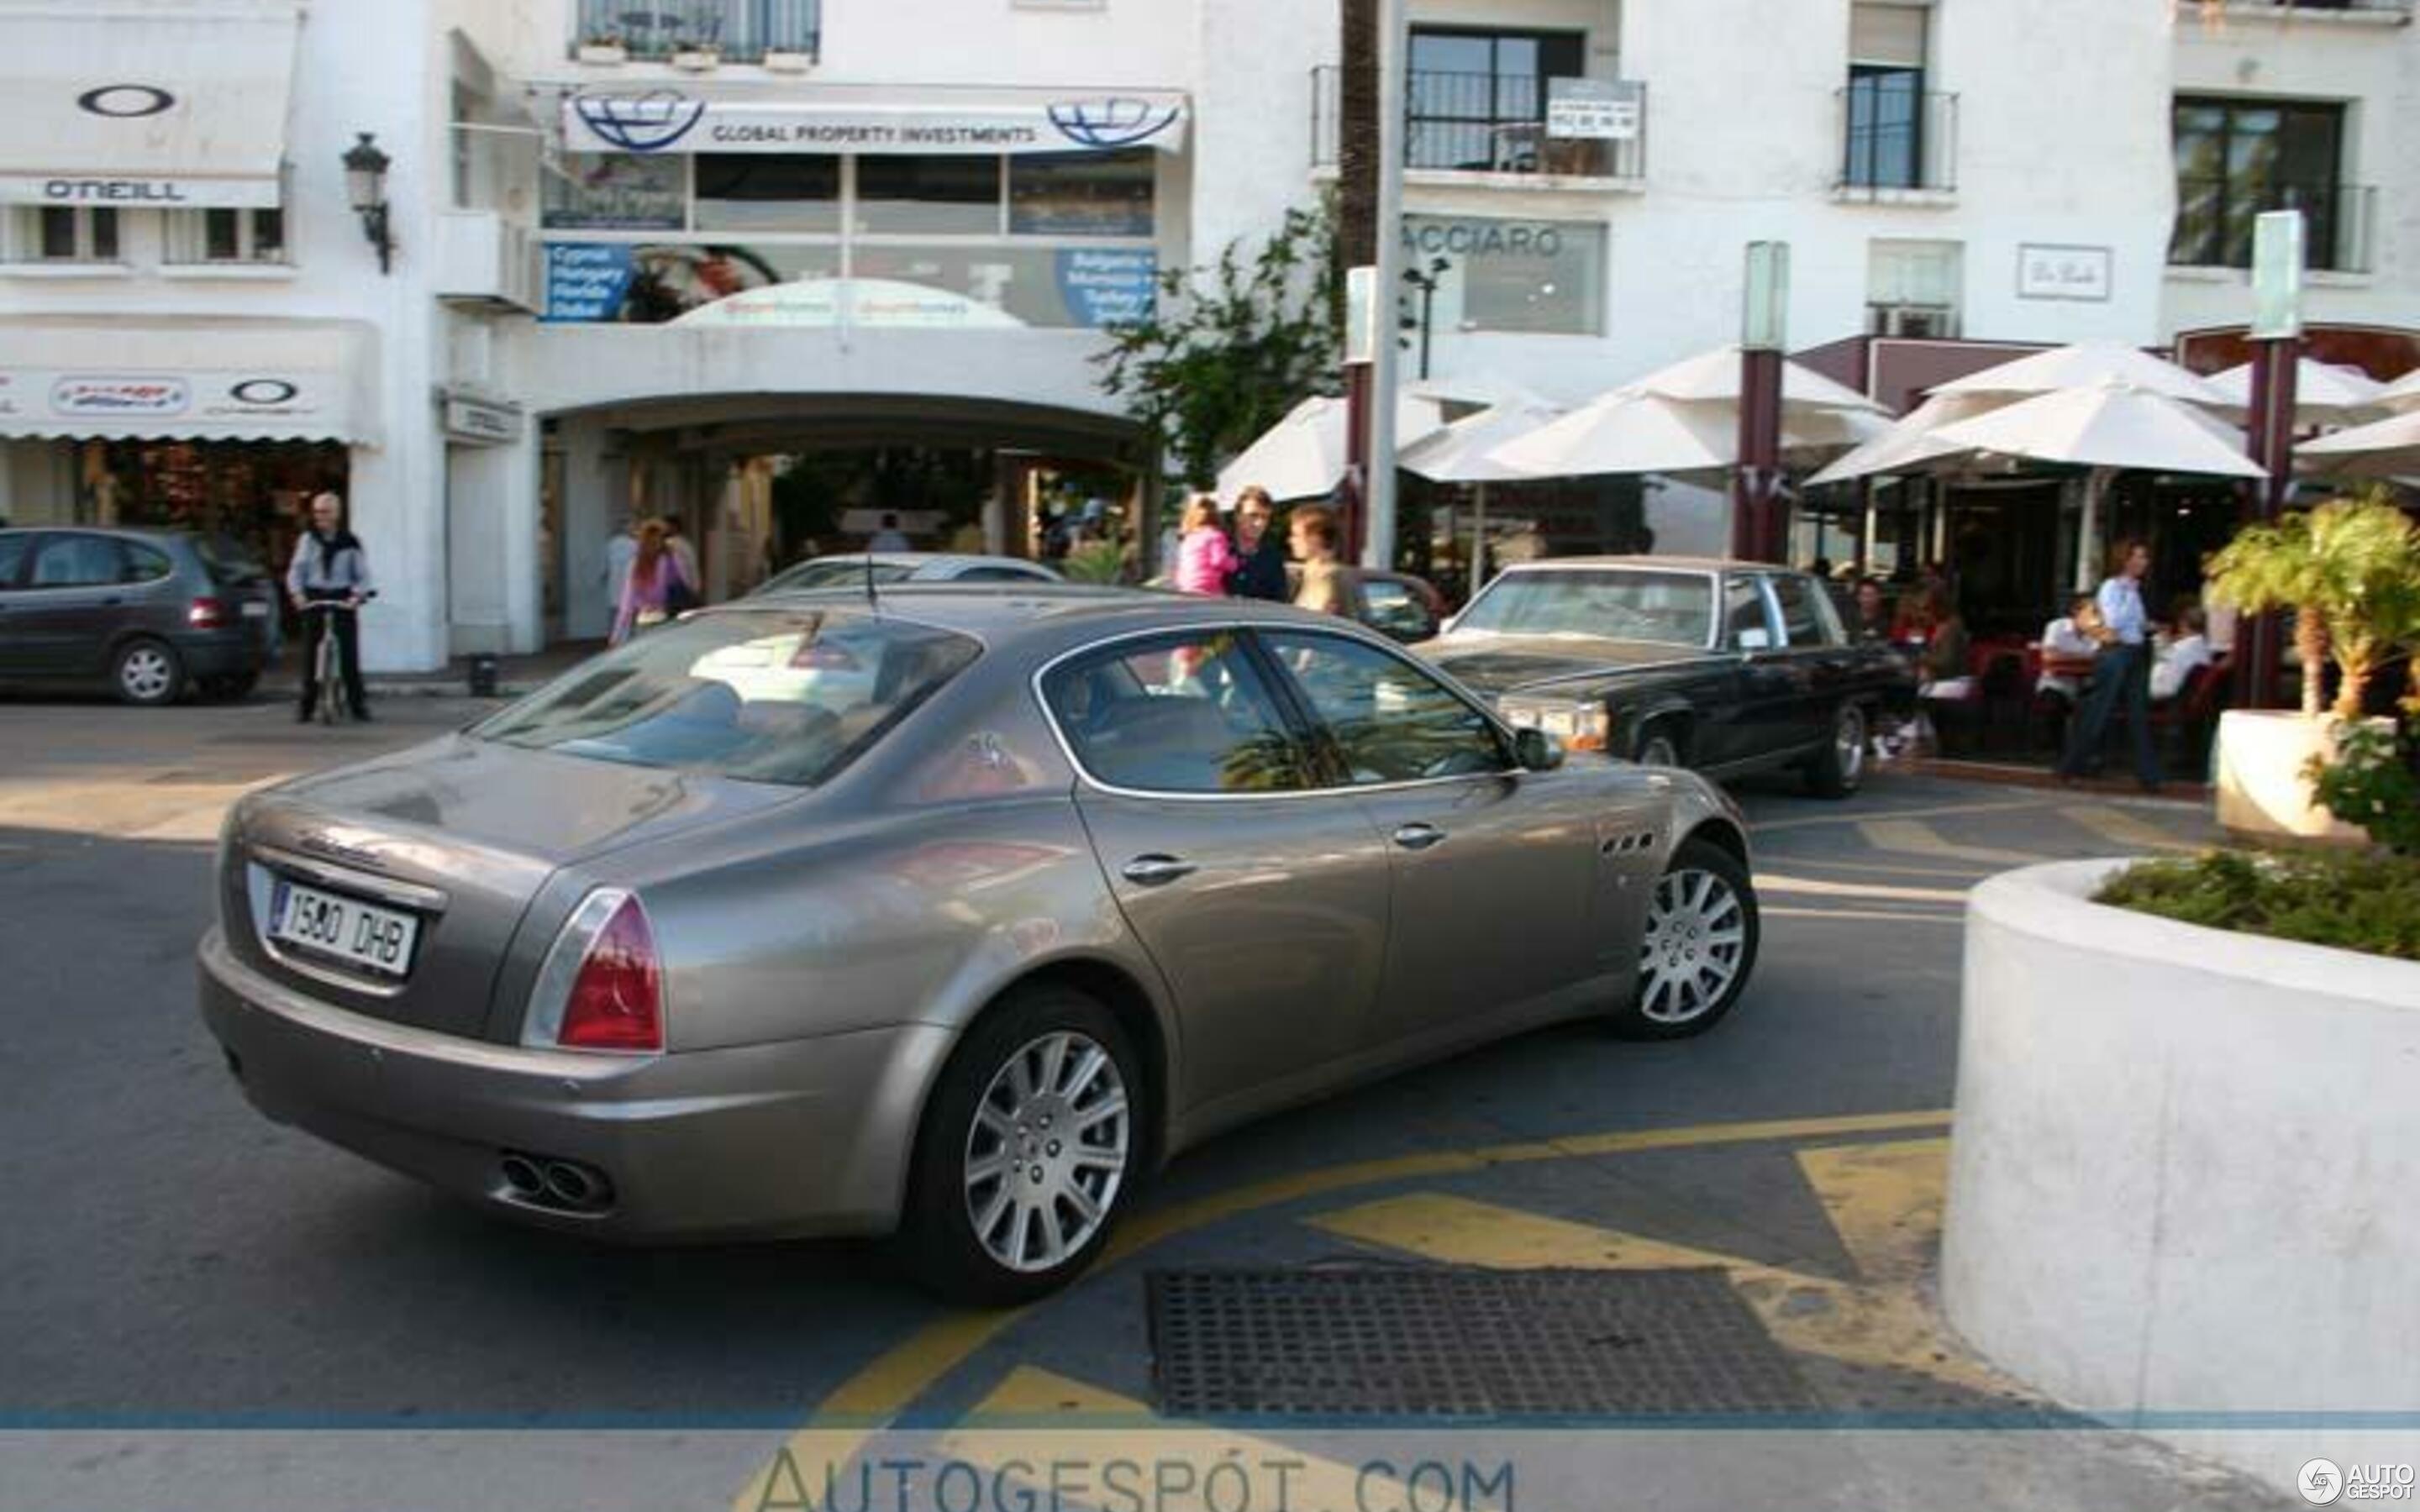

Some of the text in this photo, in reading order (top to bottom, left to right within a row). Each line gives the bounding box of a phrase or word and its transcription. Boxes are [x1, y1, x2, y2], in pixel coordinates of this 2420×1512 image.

[712, 125, 1037, 144] GLOBAL PROPERTY INVESTMENTS
[353, 911, 403, 964] DHB
